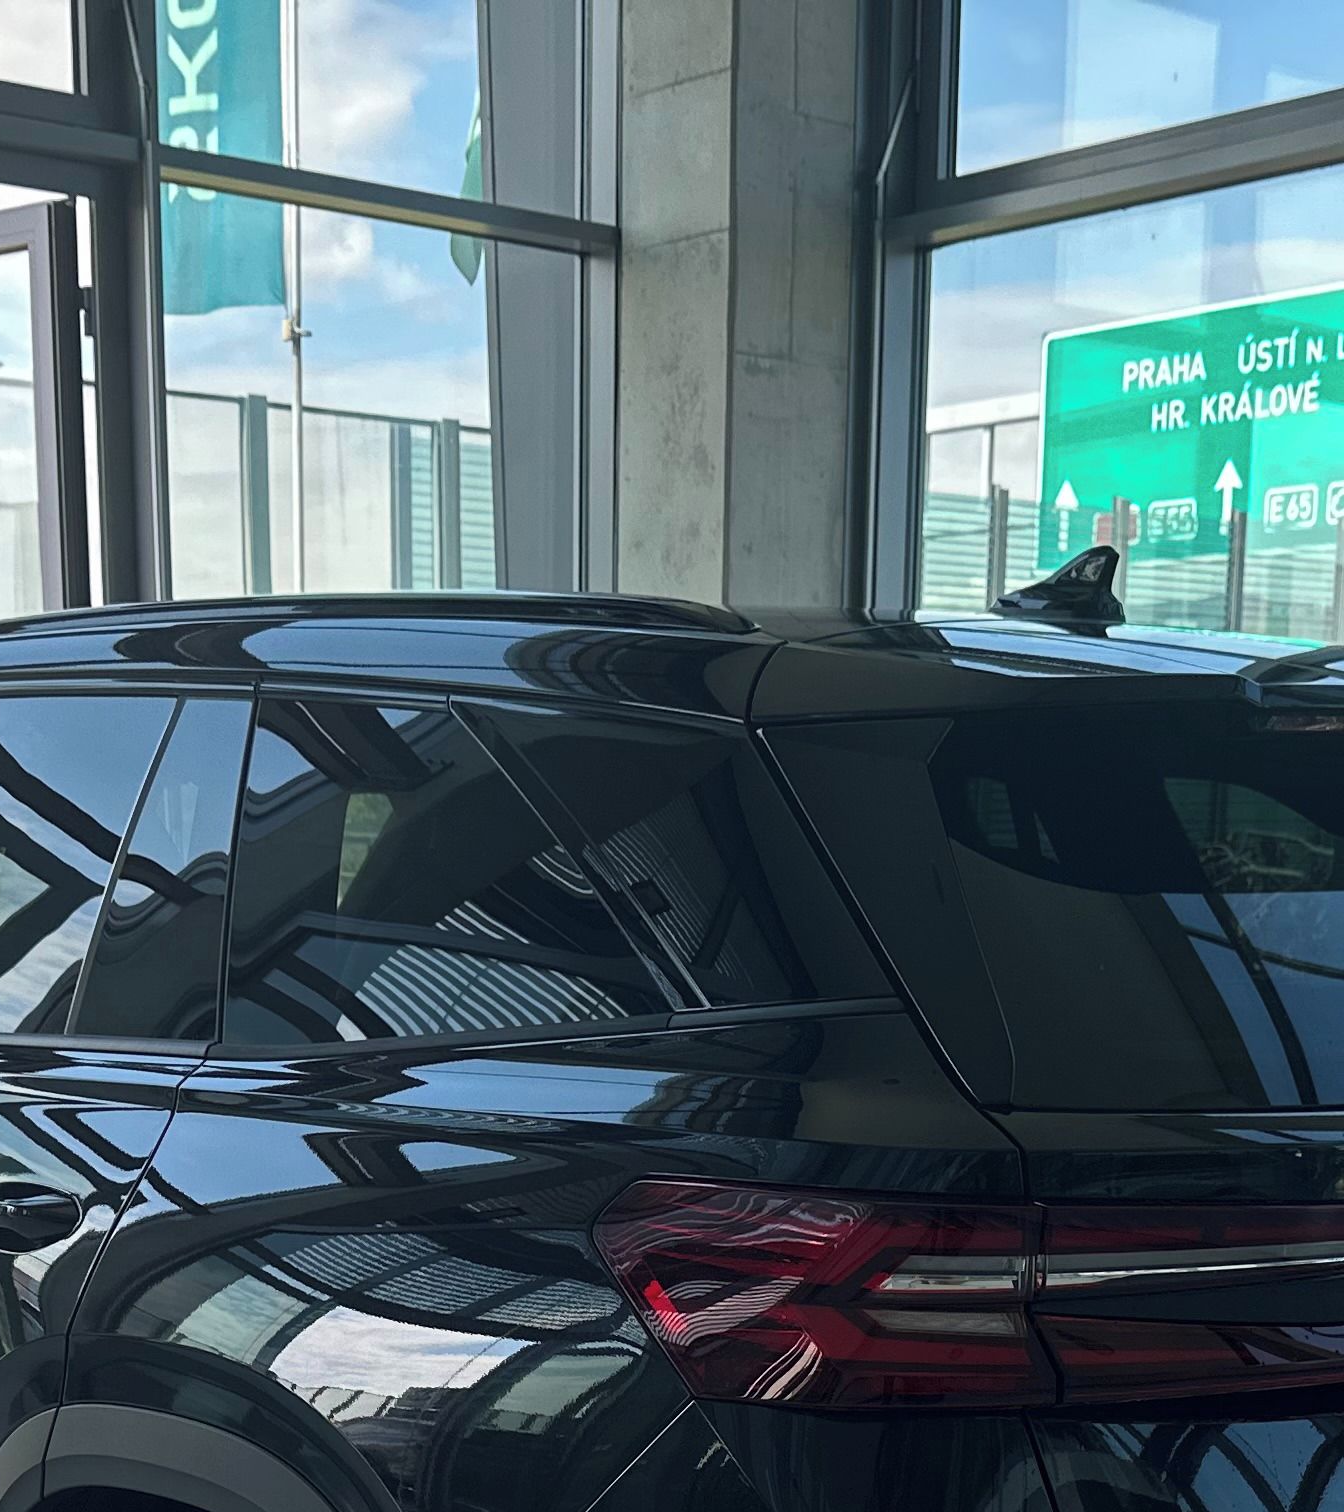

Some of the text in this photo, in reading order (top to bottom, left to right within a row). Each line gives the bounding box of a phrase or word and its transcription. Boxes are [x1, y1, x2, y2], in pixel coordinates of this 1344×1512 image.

[1122, 351, 1207, 393] PRAHA
[1237, 327, 1299, 374] ÚSTÍ
[1306, 335, 1329, 365] N.
[1150, 369, 1321, 432] HR. KRÁLOVÉ
